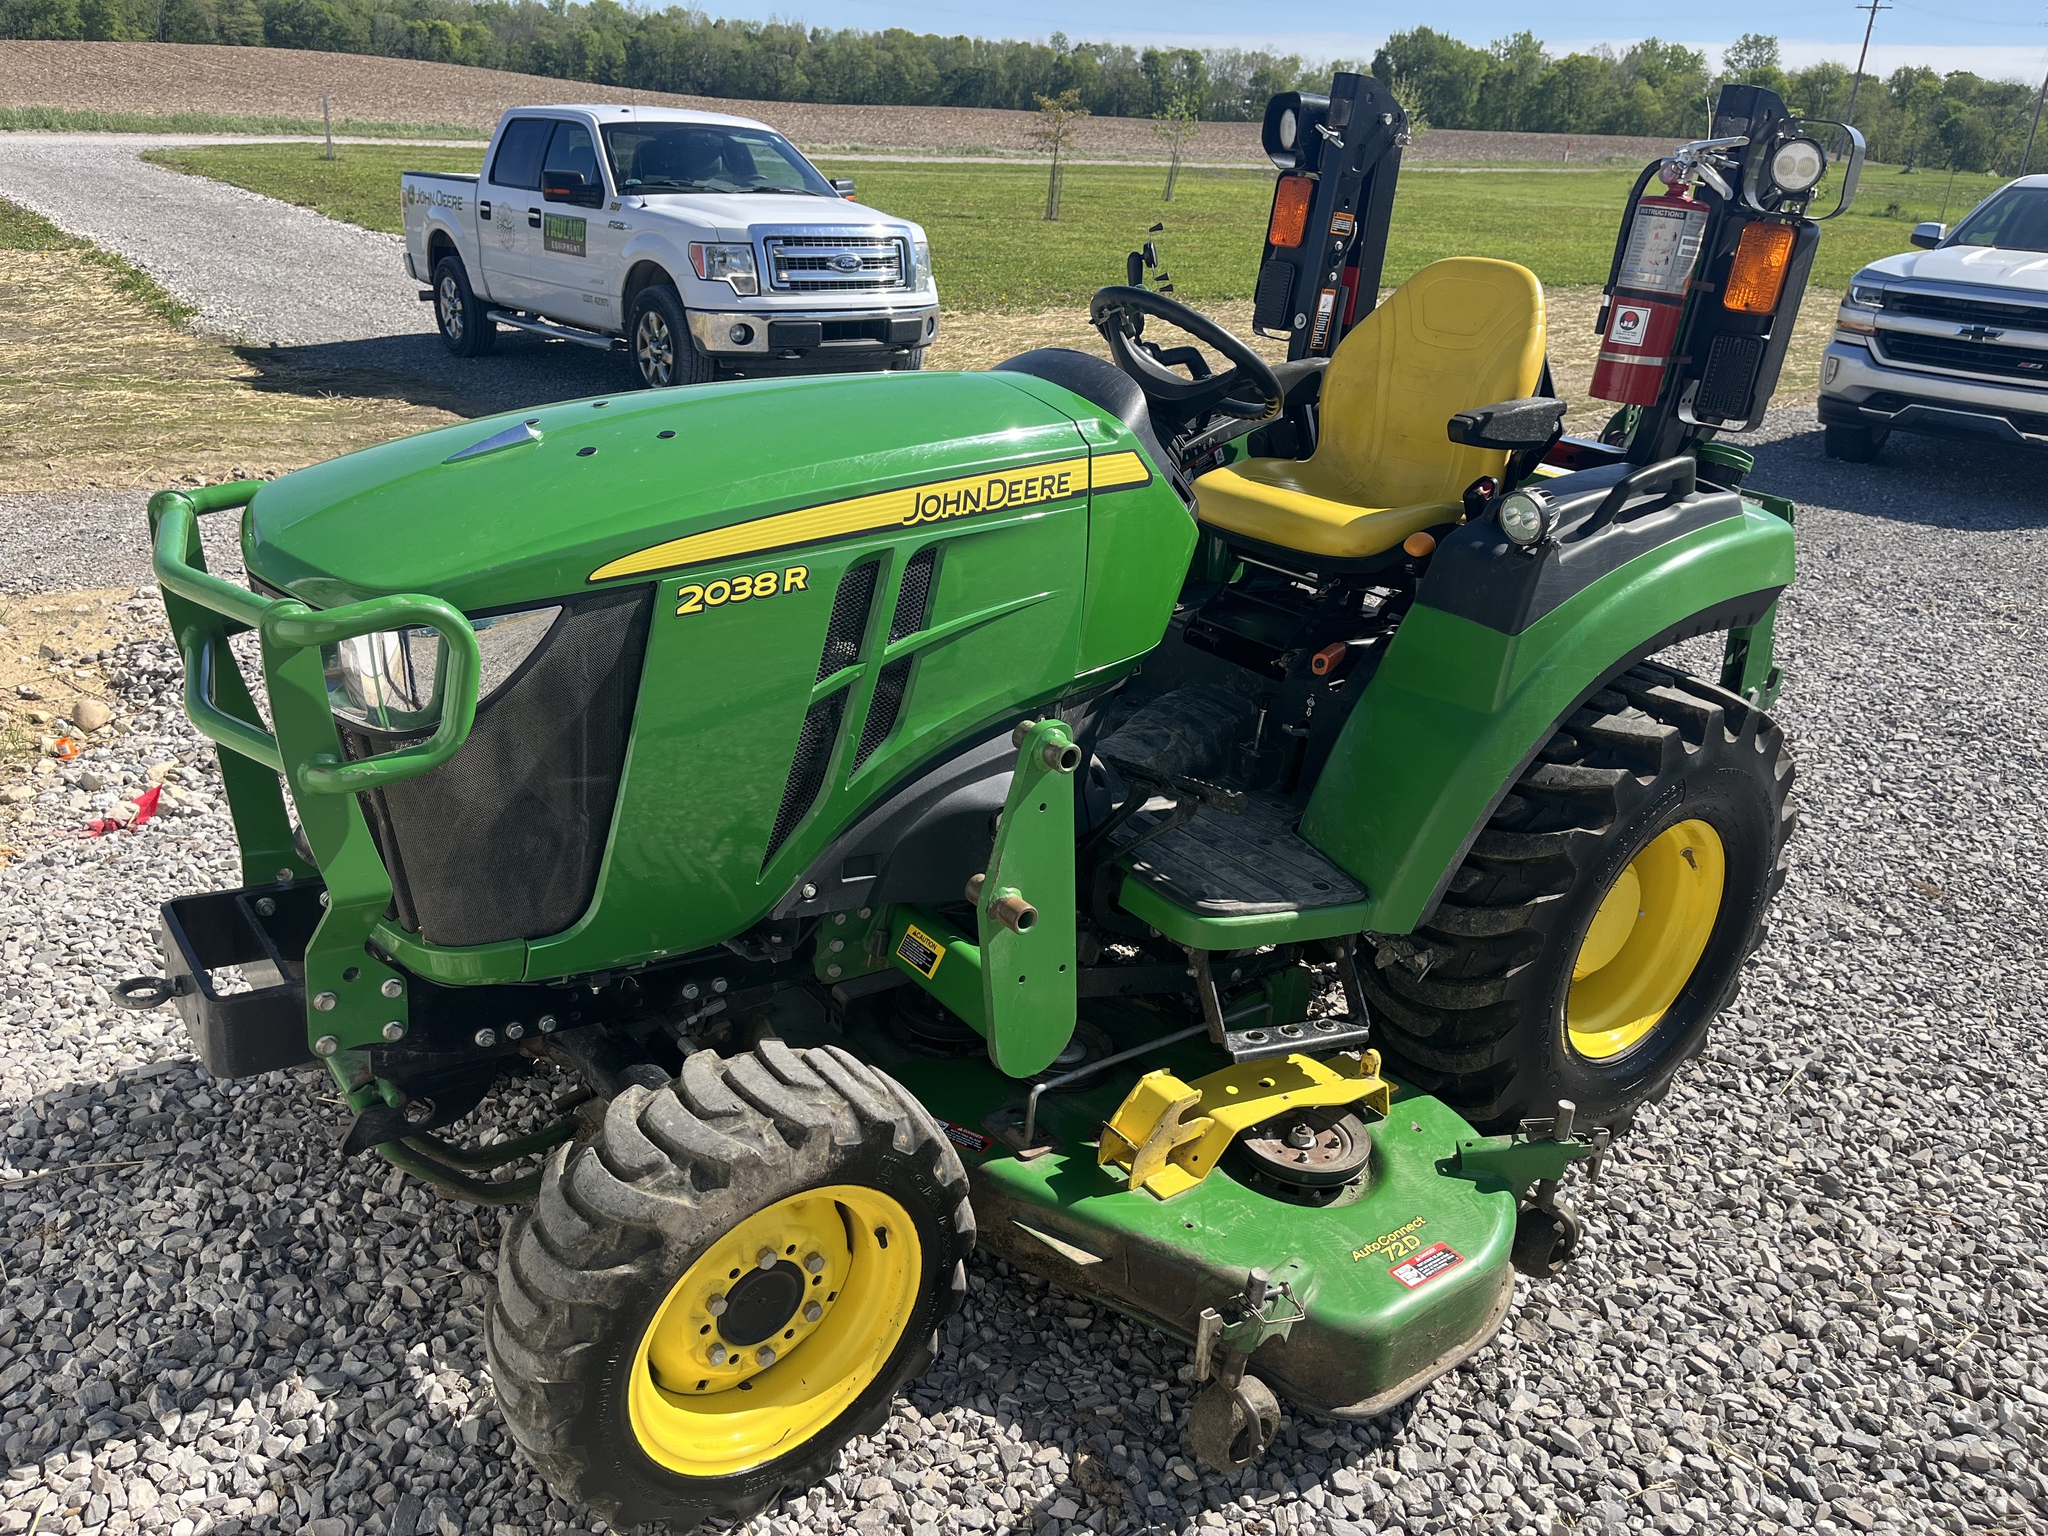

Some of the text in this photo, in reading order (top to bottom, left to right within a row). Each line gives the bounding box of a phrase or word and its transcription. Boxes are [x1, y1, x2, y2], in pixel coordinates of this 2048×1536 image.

[416, 187, 463, 211] JOHN DEERE
[1640, 207, 1685, 219] INSTRUCTIONS
[545, 215, 584, 242] TRULAND
[551, 240, 580, 253] EQUIPMENT
[840, 258, 858, 268] Ford
[902, 471, 1073, 525] JOHN DEERE
[676, 565, 809, 616] 2038 R
[916, 931, 938, 951] CAUTION
[962, 1128, 984, 1139] DANGER
[912, 1173, 952, 1268] GALAXY
[1351, 1215, 1427, 1263] AutoConnect
[1379, 1235, 1422, 1263] 72D
